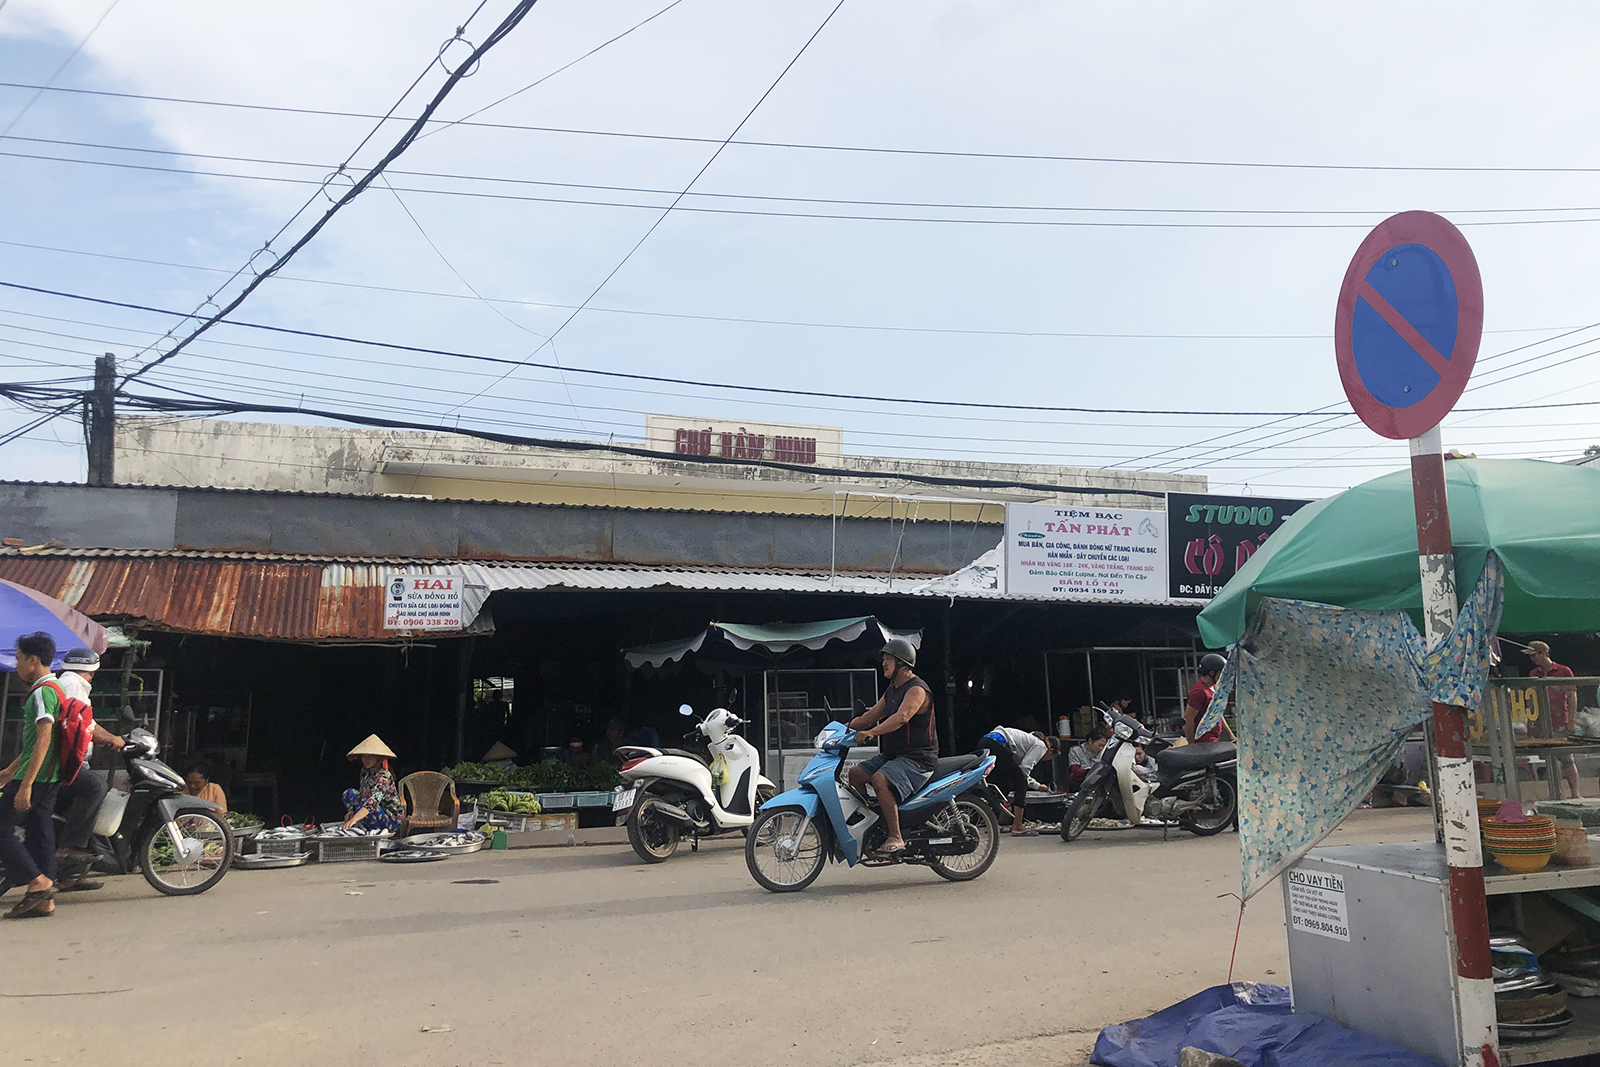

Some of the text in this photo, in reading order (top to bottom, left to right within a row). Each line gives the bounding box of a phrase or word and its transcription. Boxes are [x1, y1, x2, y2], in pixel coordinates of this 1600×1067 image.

[1054, 510, 1122, 520] TIỆM BẠC
[1186, 504, 1273, 526] STUDIO
[1044, 519, 1132, 536] TẤN PHÁT
[413, 579, 453, 590] HAI
[1289, 871, 1343, 890] CHO VAY TIỀN
